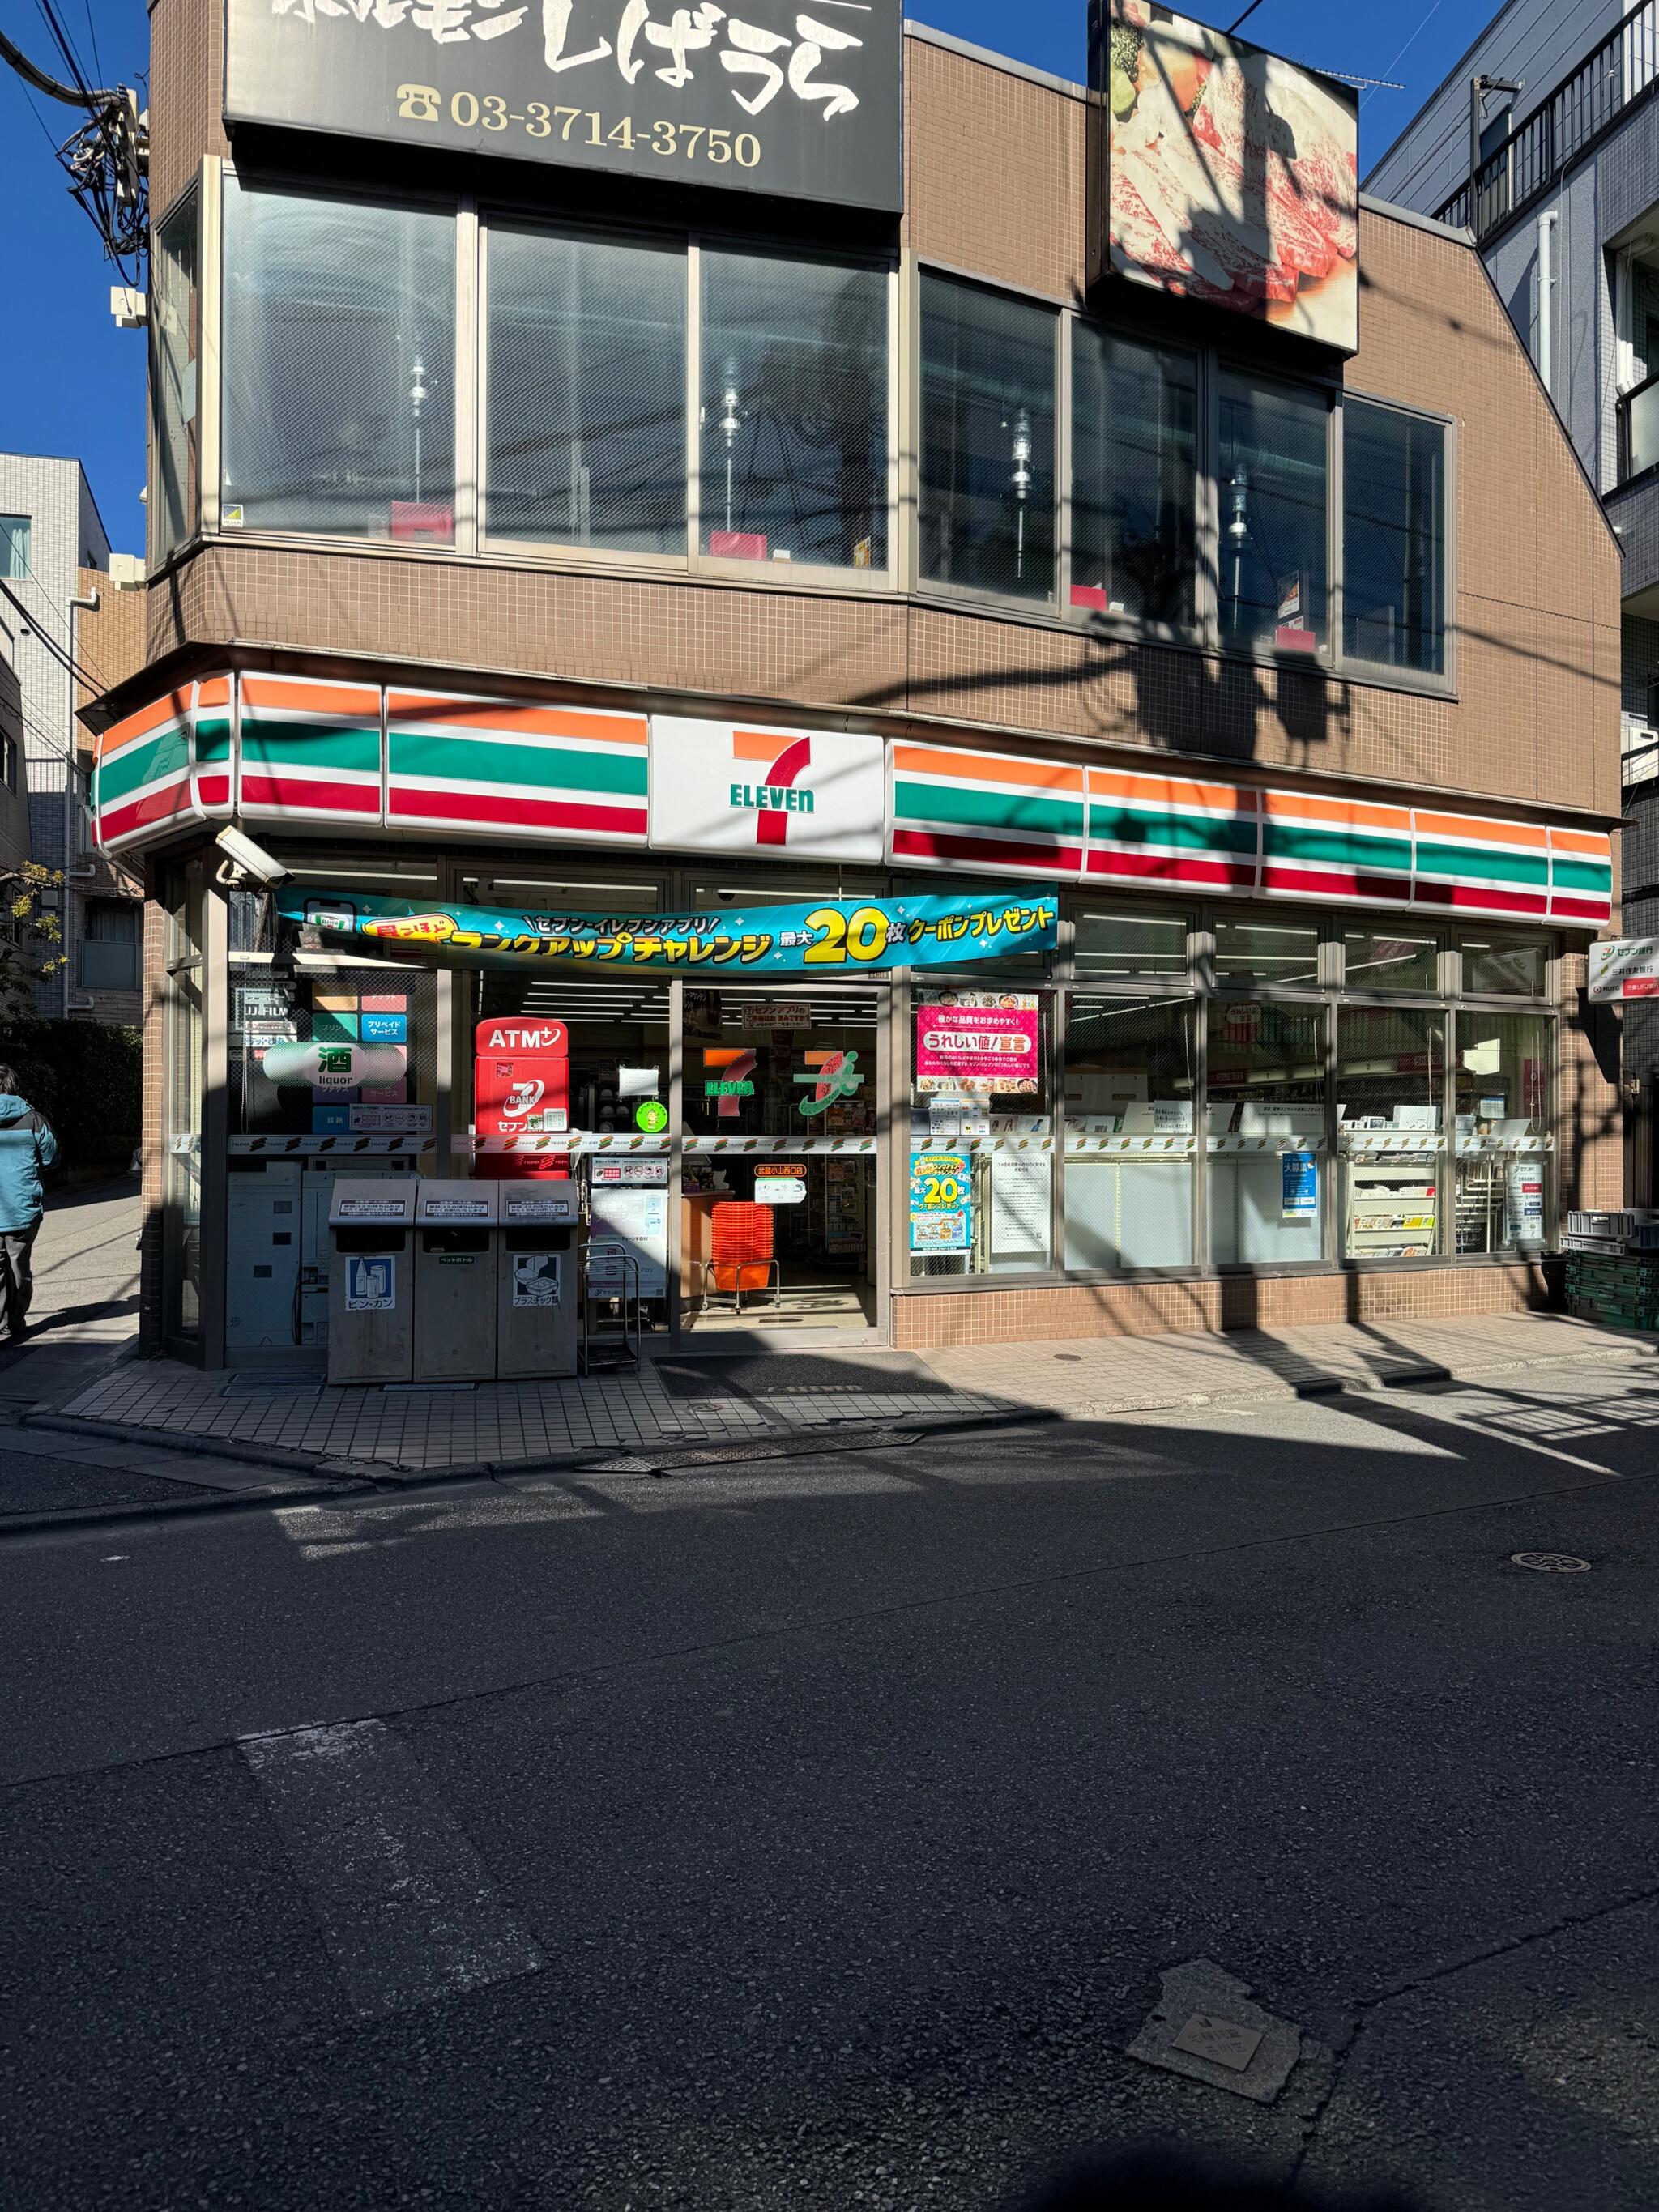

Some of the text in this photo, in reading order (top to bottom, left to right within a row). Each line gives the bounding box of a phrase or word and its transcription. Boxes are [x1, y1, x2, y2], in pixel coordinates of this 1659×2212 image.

[450, 91, 762, 168] 03-3714-3750
[450, 931, 774, 964] ランクアップチャレンジ
[908, 905, 1055, 944] クーポンプレゼント
[1618, 945, 1653, 957] セブン銀行
[938, 1014, 1019, 1026] 確かな品質をお求めやすく!
[928, 1034, 1026, 1052] うれしい値!宣言
[318, 1046, 352, 1073] 酒
[319, 1076, 353, 1085] liquor
[348, 1299, 394, 1310] ビン・カン
[513, 1295, 560, 1306] プラスチック類
